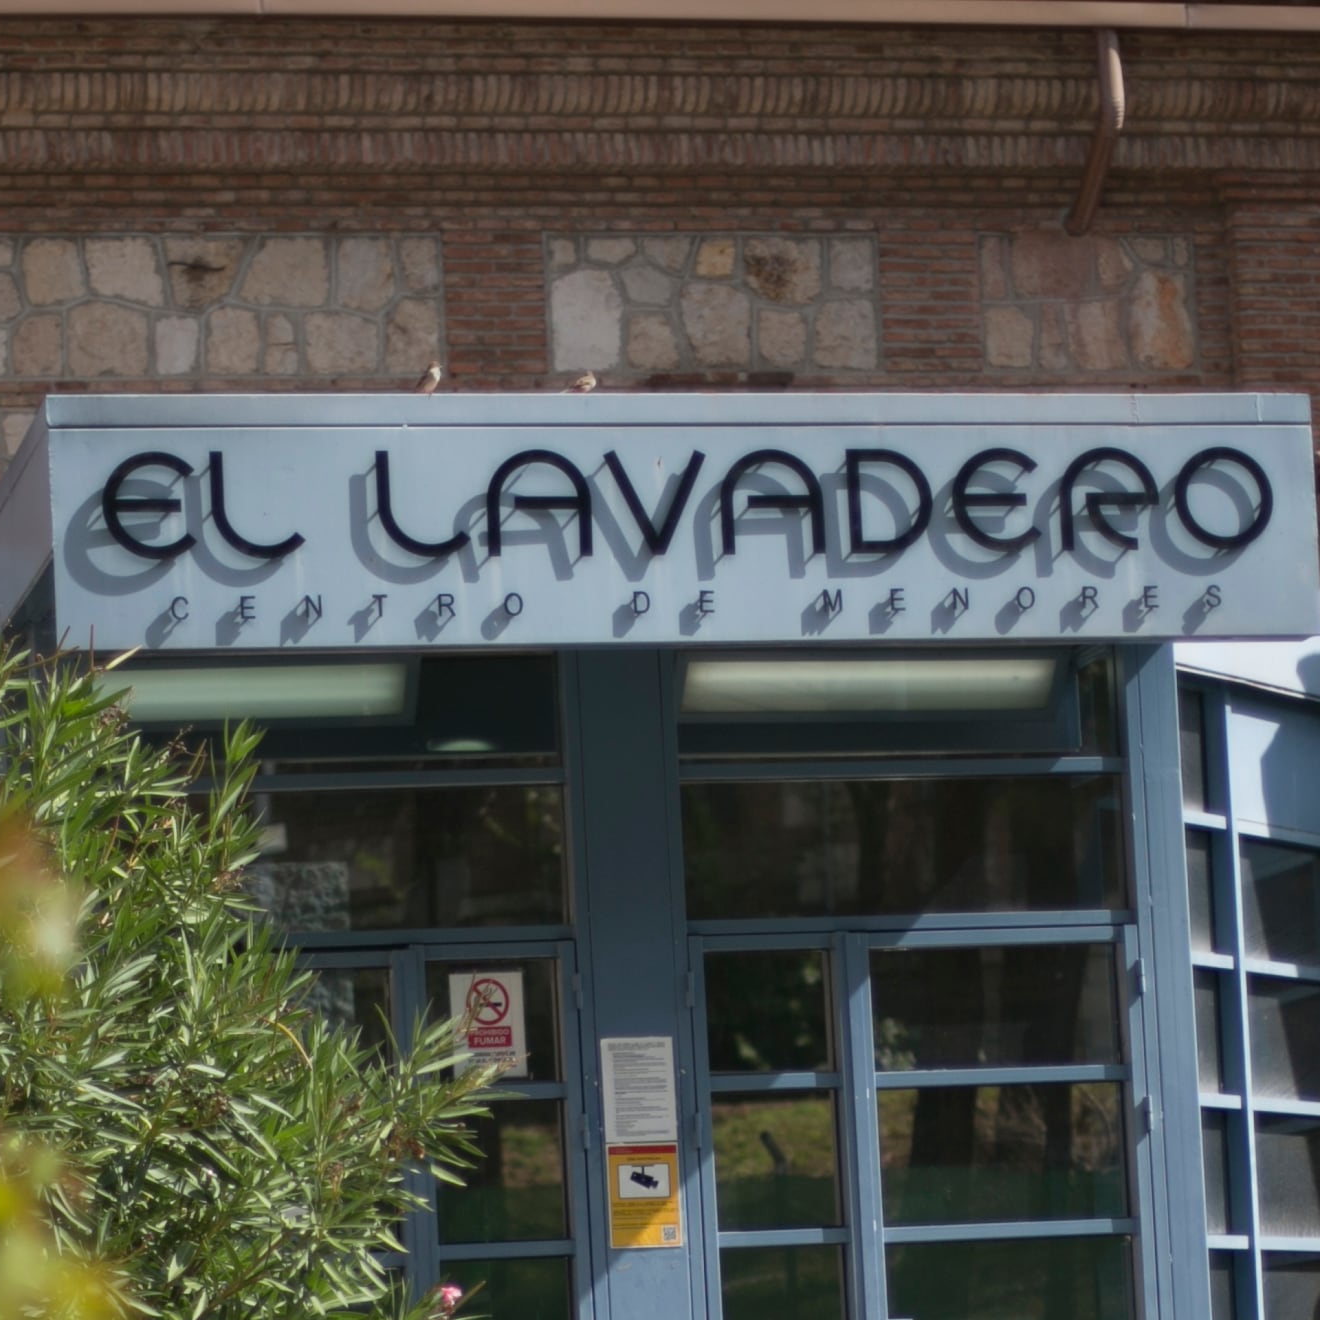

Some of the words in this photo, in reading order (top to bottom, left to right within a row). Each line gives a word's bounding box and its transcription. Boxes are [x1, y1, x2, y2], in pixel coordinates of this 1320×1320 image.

[102, 451, 306, 560] EL
[375, 446, 1274, 557] LAVADERO
[170, 592, 524, 621] CENTRO
[632, 590, 715, 614] DE
[821, 584, 1222, 613] MENORES
[474, 1035, 507, 1046] FUMAR
